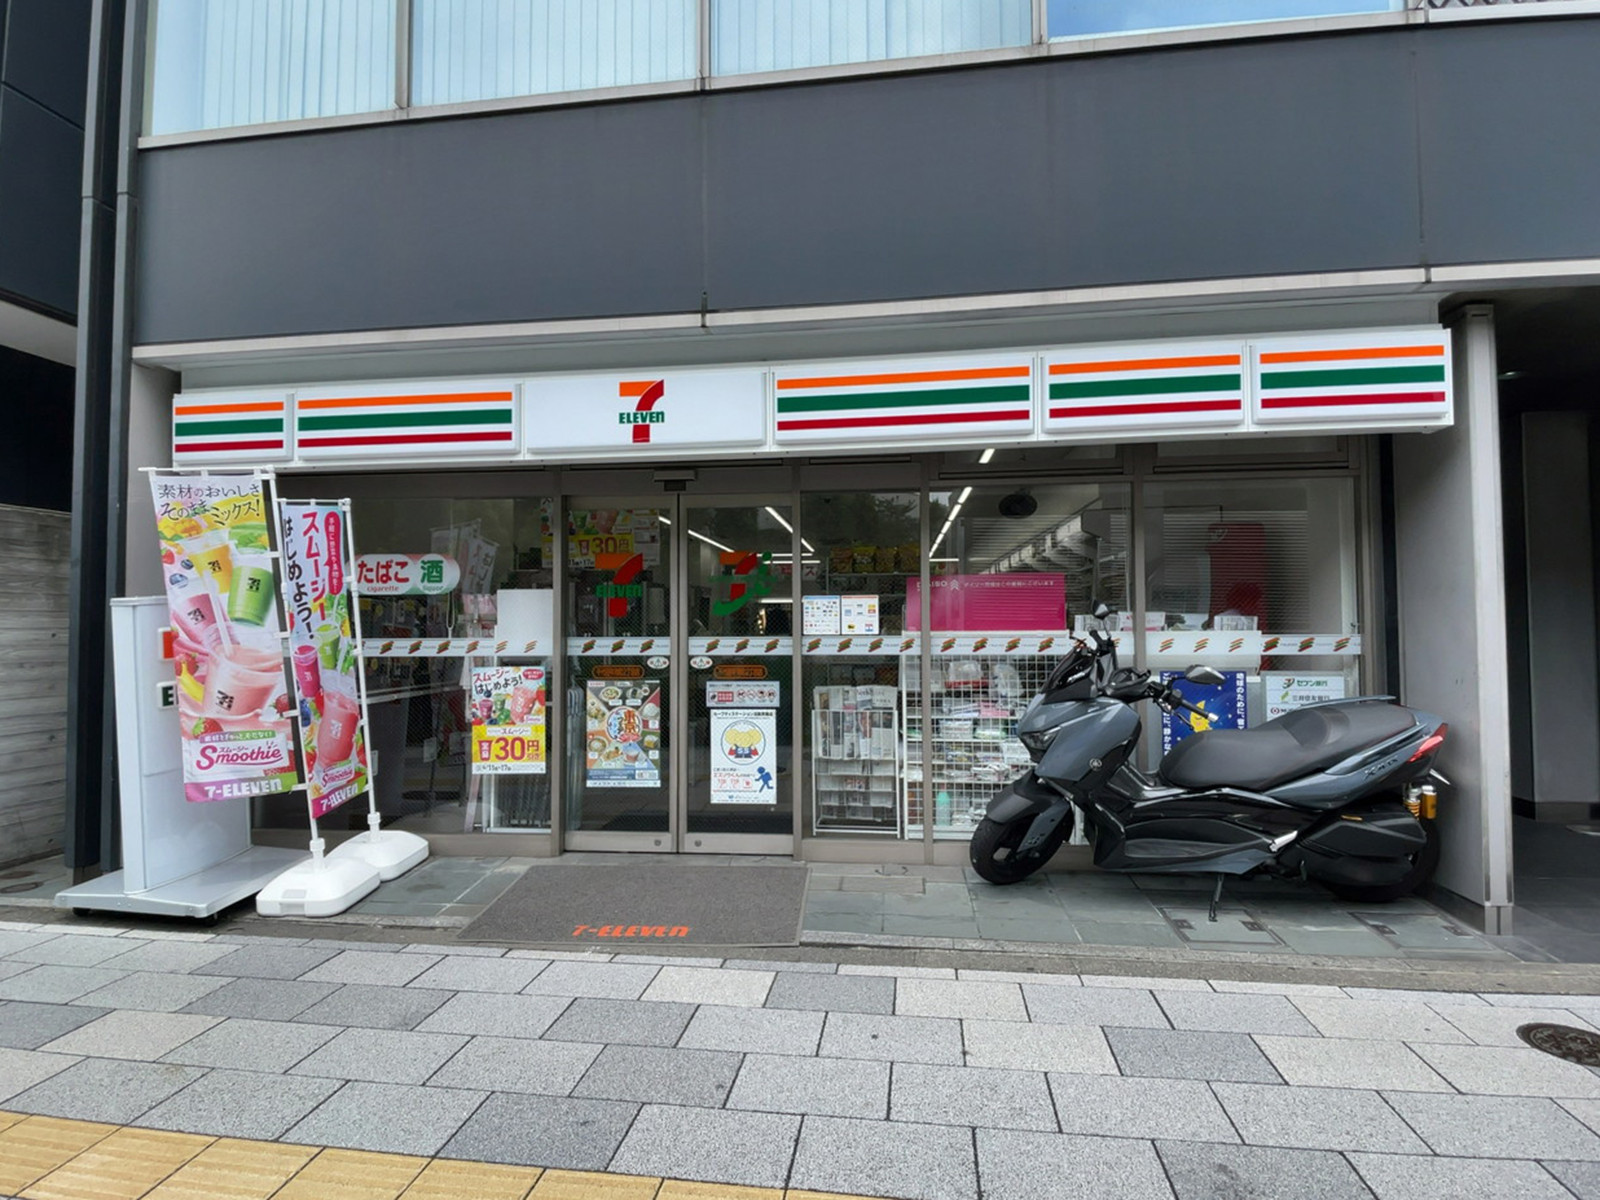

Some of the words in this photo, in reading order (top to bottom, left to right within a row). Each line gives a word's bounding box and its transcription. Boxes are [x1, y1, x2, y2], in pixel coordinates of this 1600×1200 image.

[618, 378, 665, 444] 7
[618, 411, 666, 425] ELEVEN
[158, 483, 261, 500] 素材のおいしさ
[302, 511, 326, 621] スムージー
[357, 558, 410, 584] たばこ
[420, 559, 444, 583] 酒
[472, 668, 511, 683] スムージー
[1296, 679, 1328, 687] セブン銀行
[195, 745, 283, 771] Smoothie
[203, 778, 283, 799] 7-ELEVEN
[571, 924, 689, 938] 7-ELEVEN
